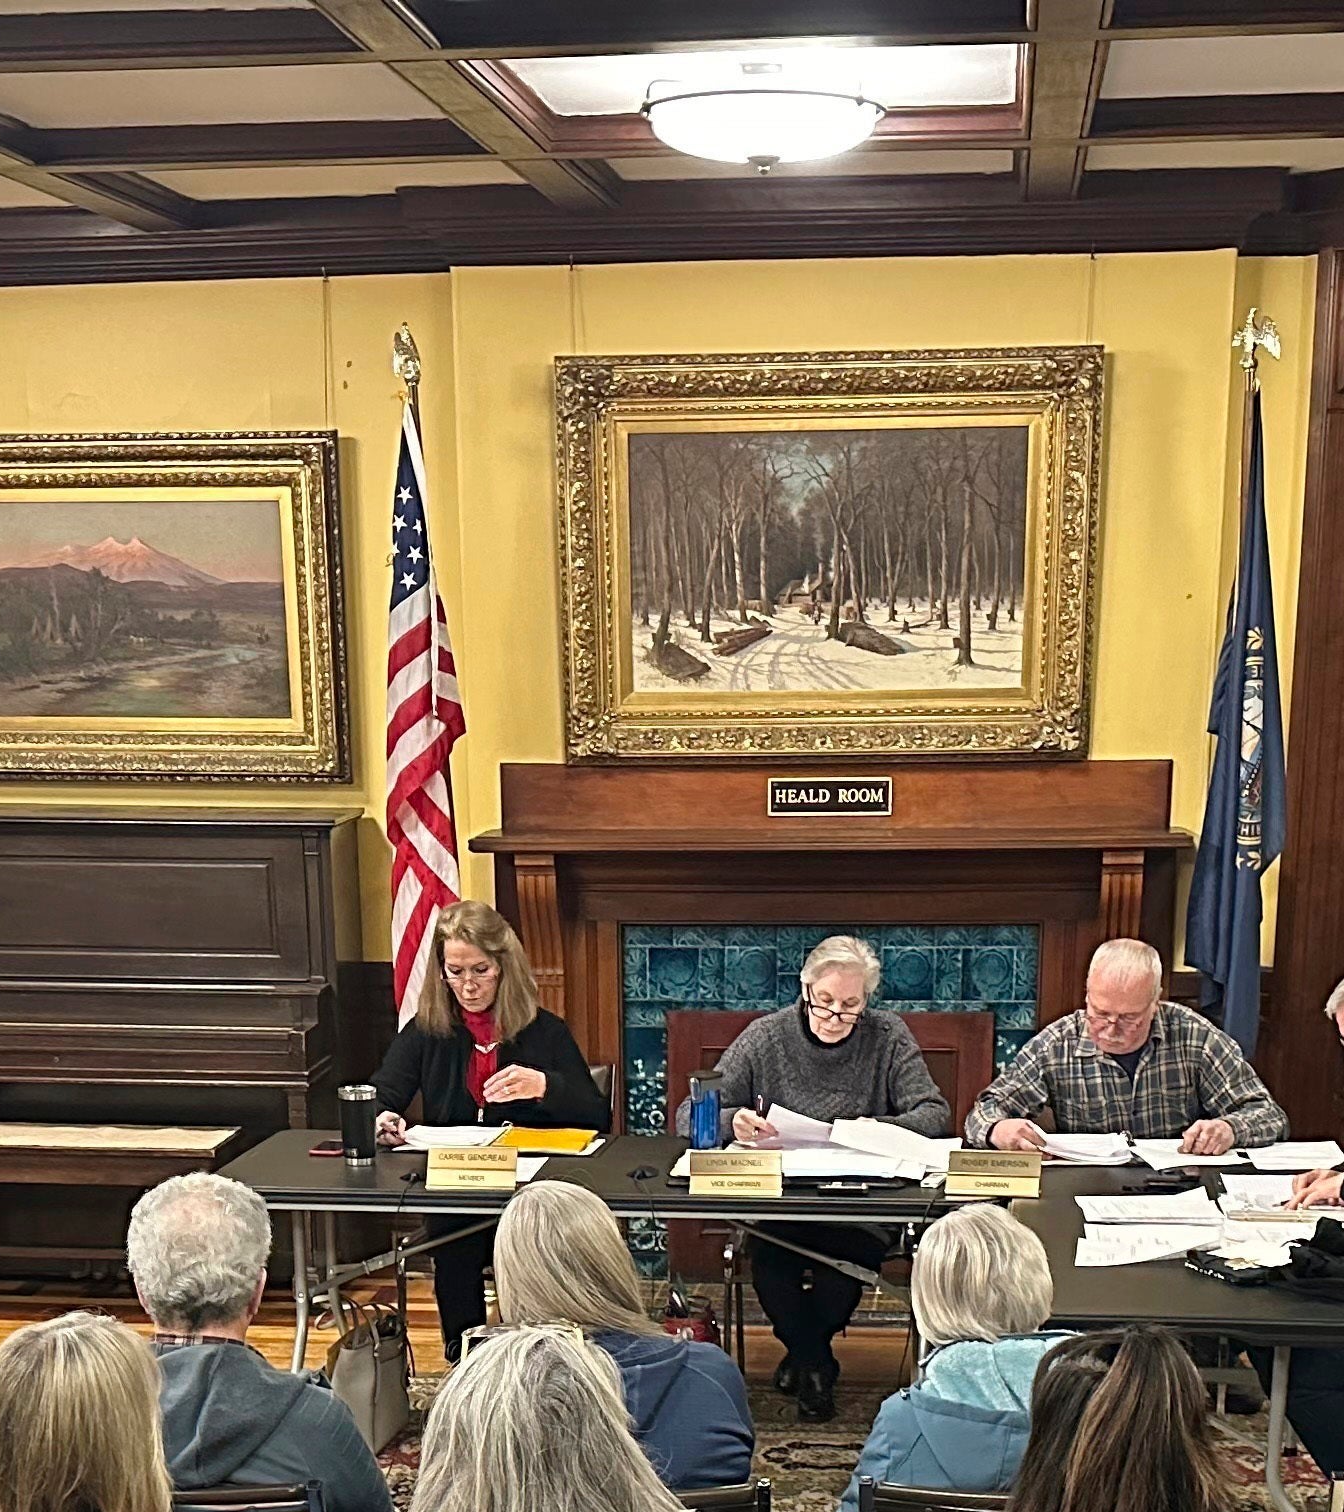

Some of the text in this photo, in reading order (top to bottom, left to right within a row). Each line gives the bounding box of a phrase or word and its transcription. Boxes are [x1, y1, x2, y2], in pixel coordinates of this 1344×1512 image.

[775, 788, 884, 804] HEALD ROOM
[706, 1159, 728, 1167] LINDA
[961, 1158, 1030, 1168] ROGER EMERSON
[974, 1181, 1010, 1189] CHAIRMAN
